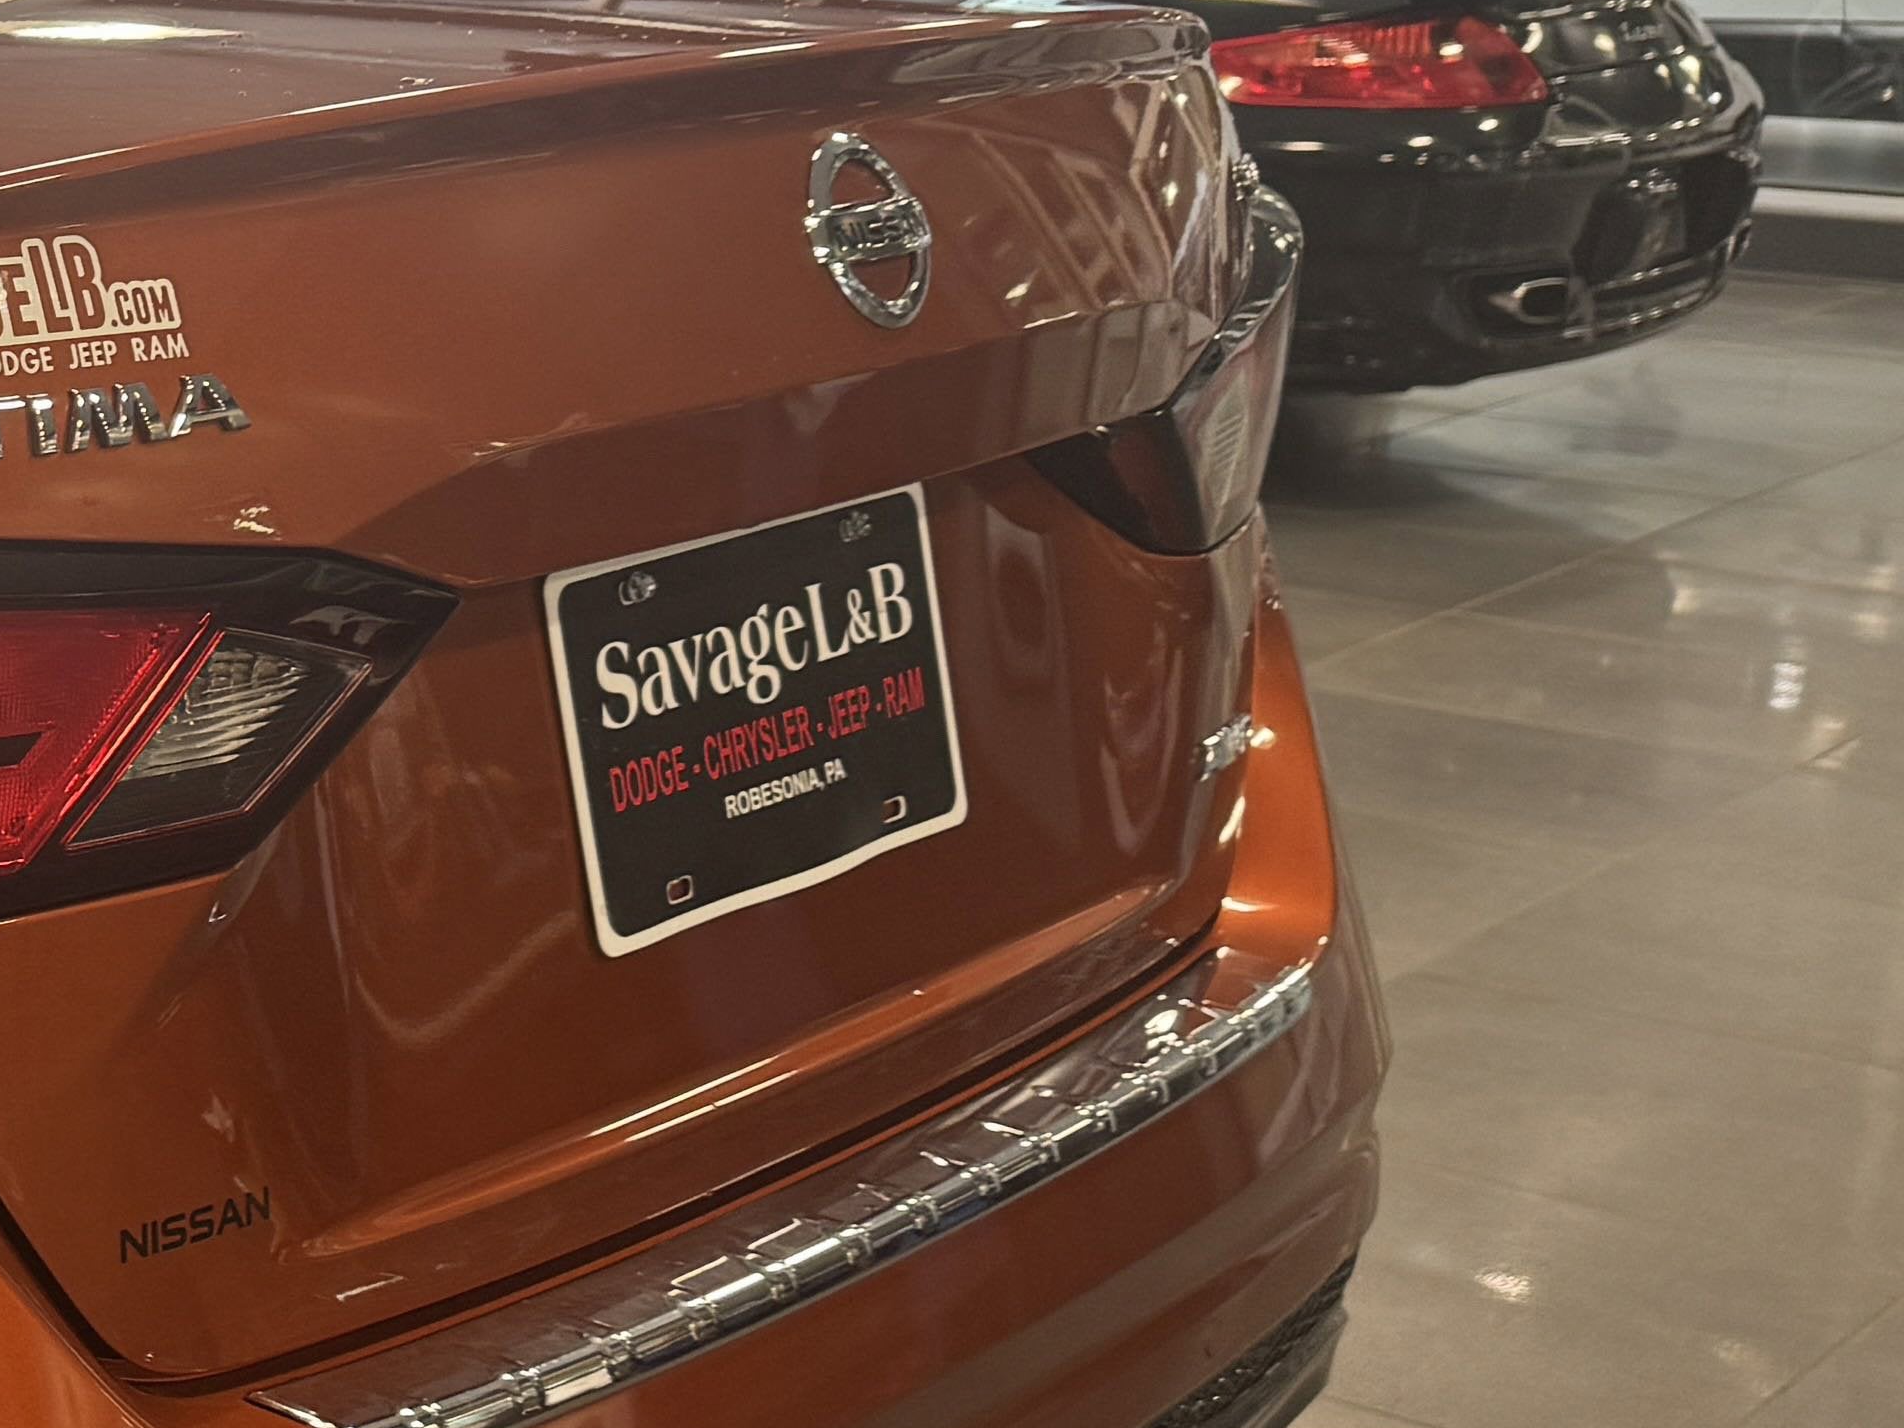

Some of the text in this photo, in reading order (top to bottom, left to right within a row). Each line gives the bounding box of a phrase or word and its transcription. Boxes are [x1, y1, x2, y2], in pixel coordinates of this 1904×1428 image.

[69, 340, 118, 369] JEEP
[131, 333, 190, 363] RAM
[609, 745, 690, 813] DODGE
[703, 705, 814, 781] CHRYSLER
[827, 684, 872, 740] JEEP
[884, 667, 926, 719] RAM
[724, 758, 848, 820] ROBESONIA, PA
[119, 1185, 270, 1264] NISSAN
